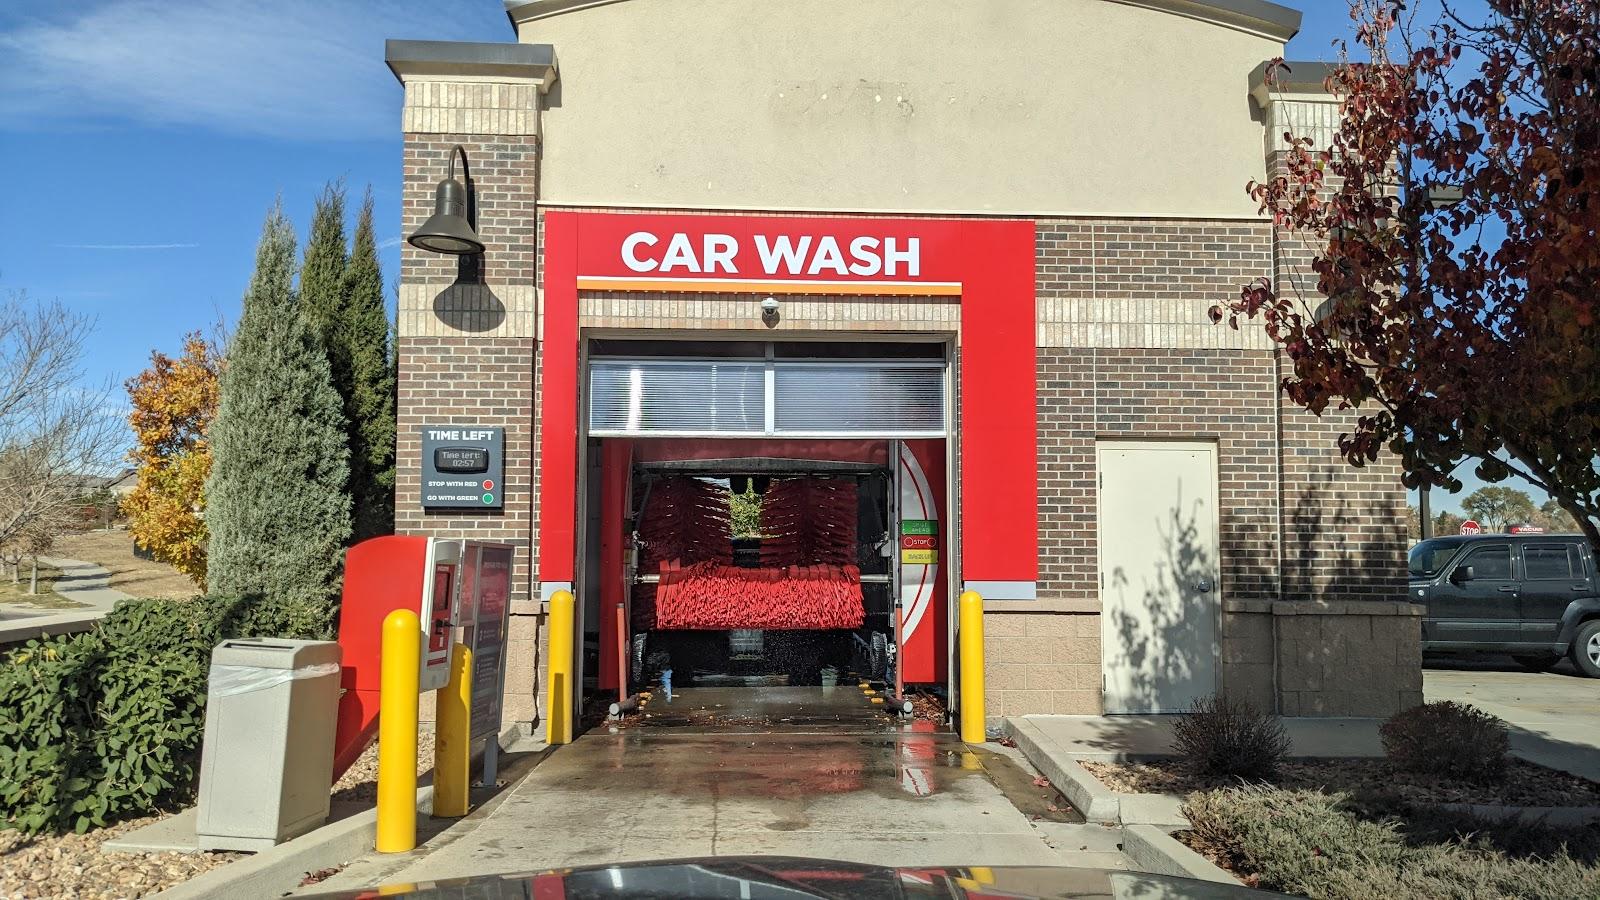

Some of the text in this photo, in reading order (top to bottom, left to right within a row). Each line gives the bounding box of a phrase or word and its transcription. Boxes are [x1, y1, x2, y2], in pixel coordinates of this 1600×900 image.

[620, 231, 920, 277] CAR WASH
[428, 430, 494, 440] TIME LEFT
[442, 451, 459, 459] Time
[1461, 526, 1479, 536] STOP
